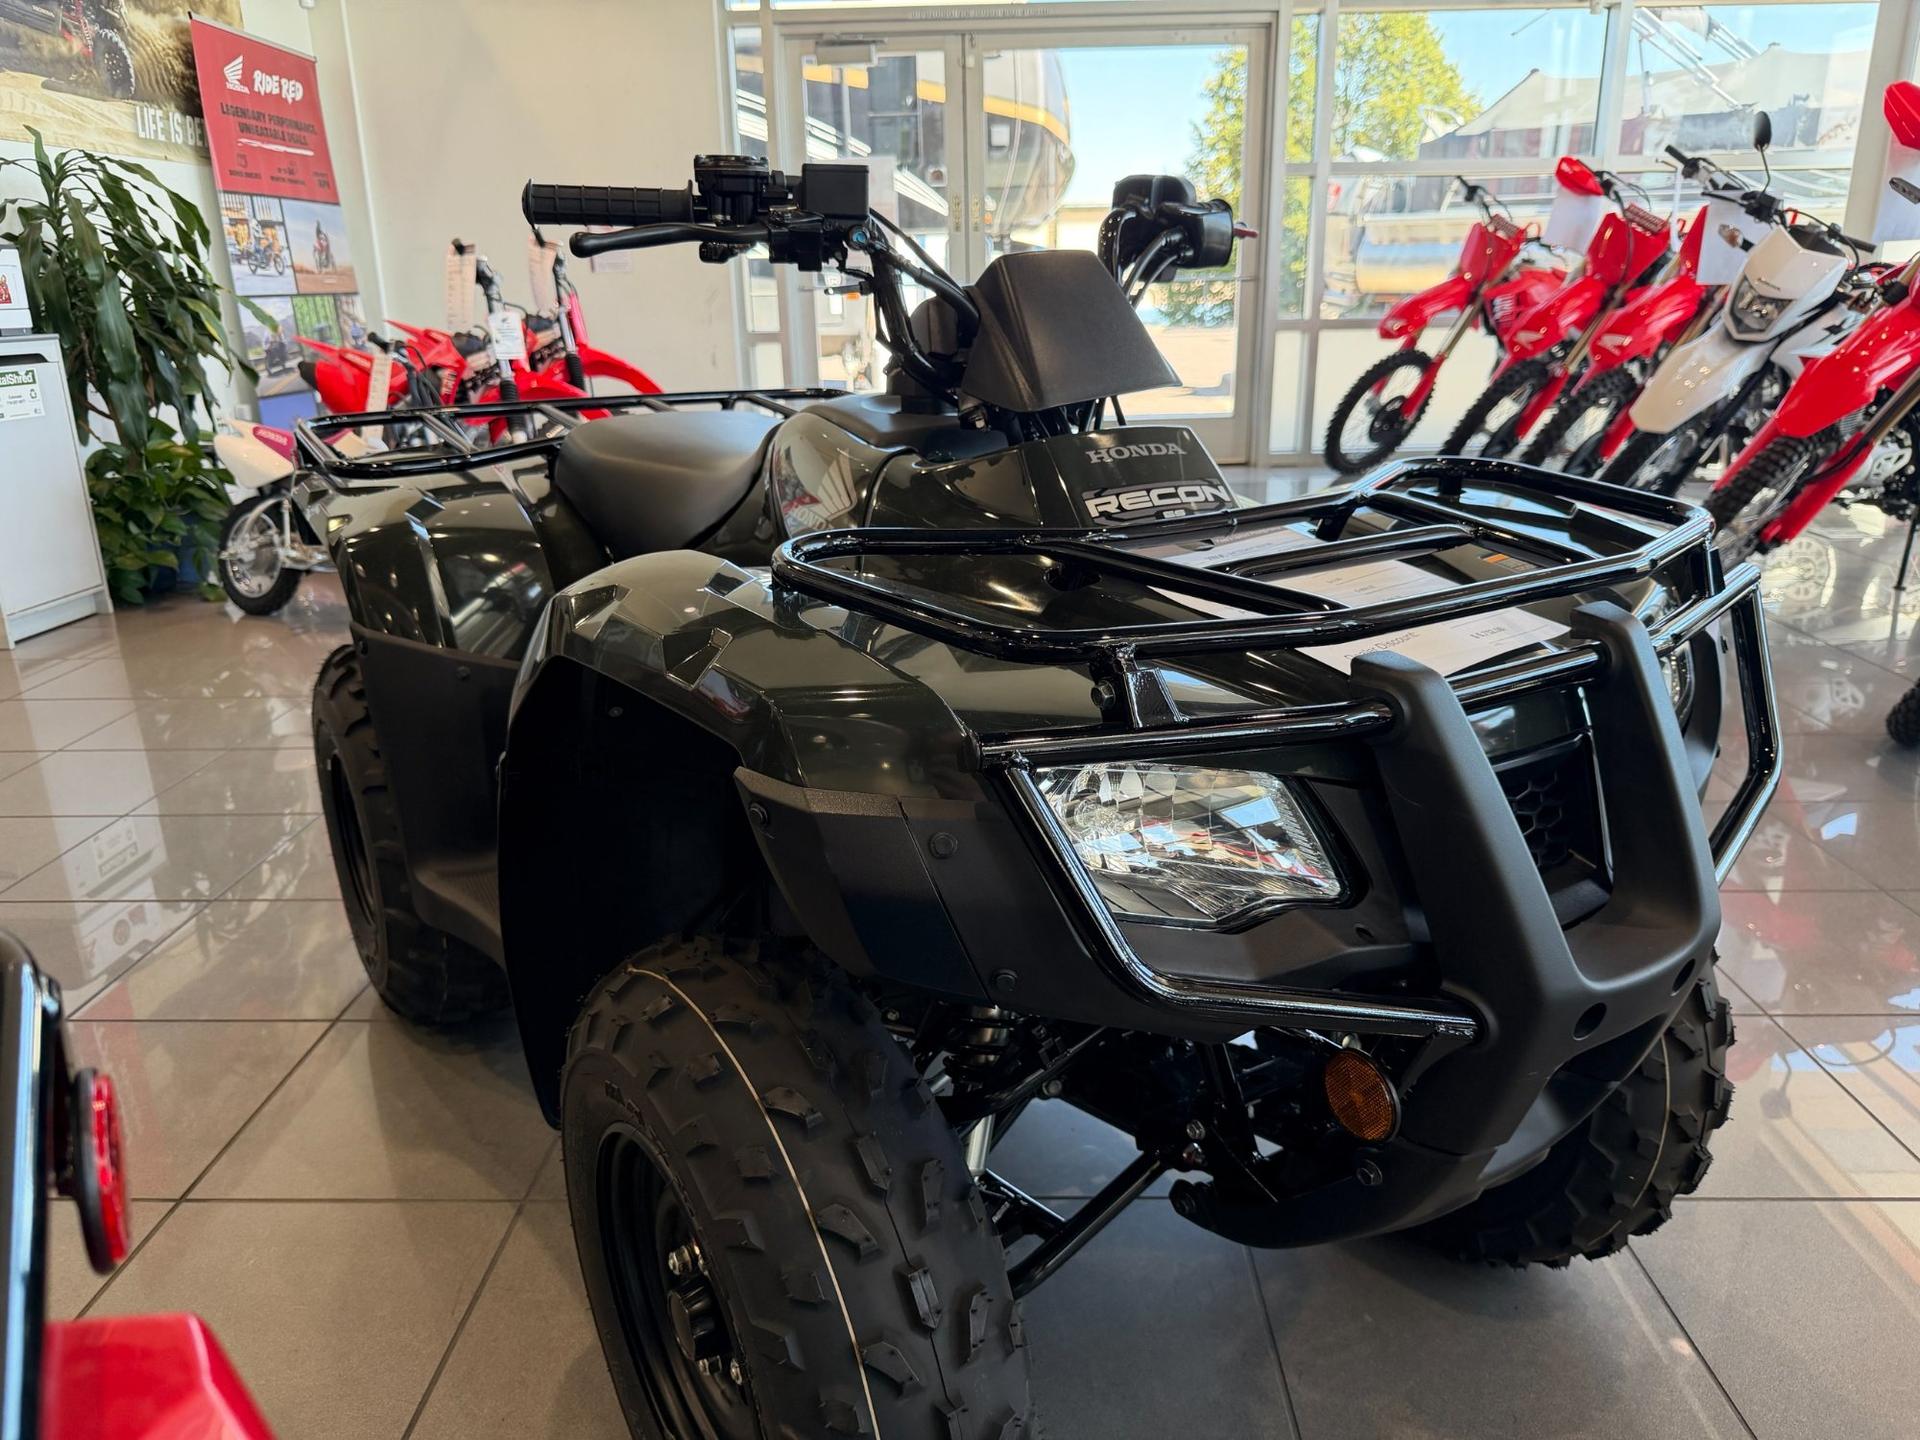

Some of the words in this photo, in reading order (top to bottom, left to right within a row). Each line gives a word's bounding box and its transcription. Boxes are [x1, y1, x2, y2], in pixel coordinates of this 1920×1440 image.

[253, 69, 280, 96] RIDE
[281, 78, 304, 104] RED
[136, 106, 166, 142] LIFE
[169, 111, 183, 145] IS
[1086, 442, 1188, 464] HONDA
[1084, 485, 1231, 518] RECON
